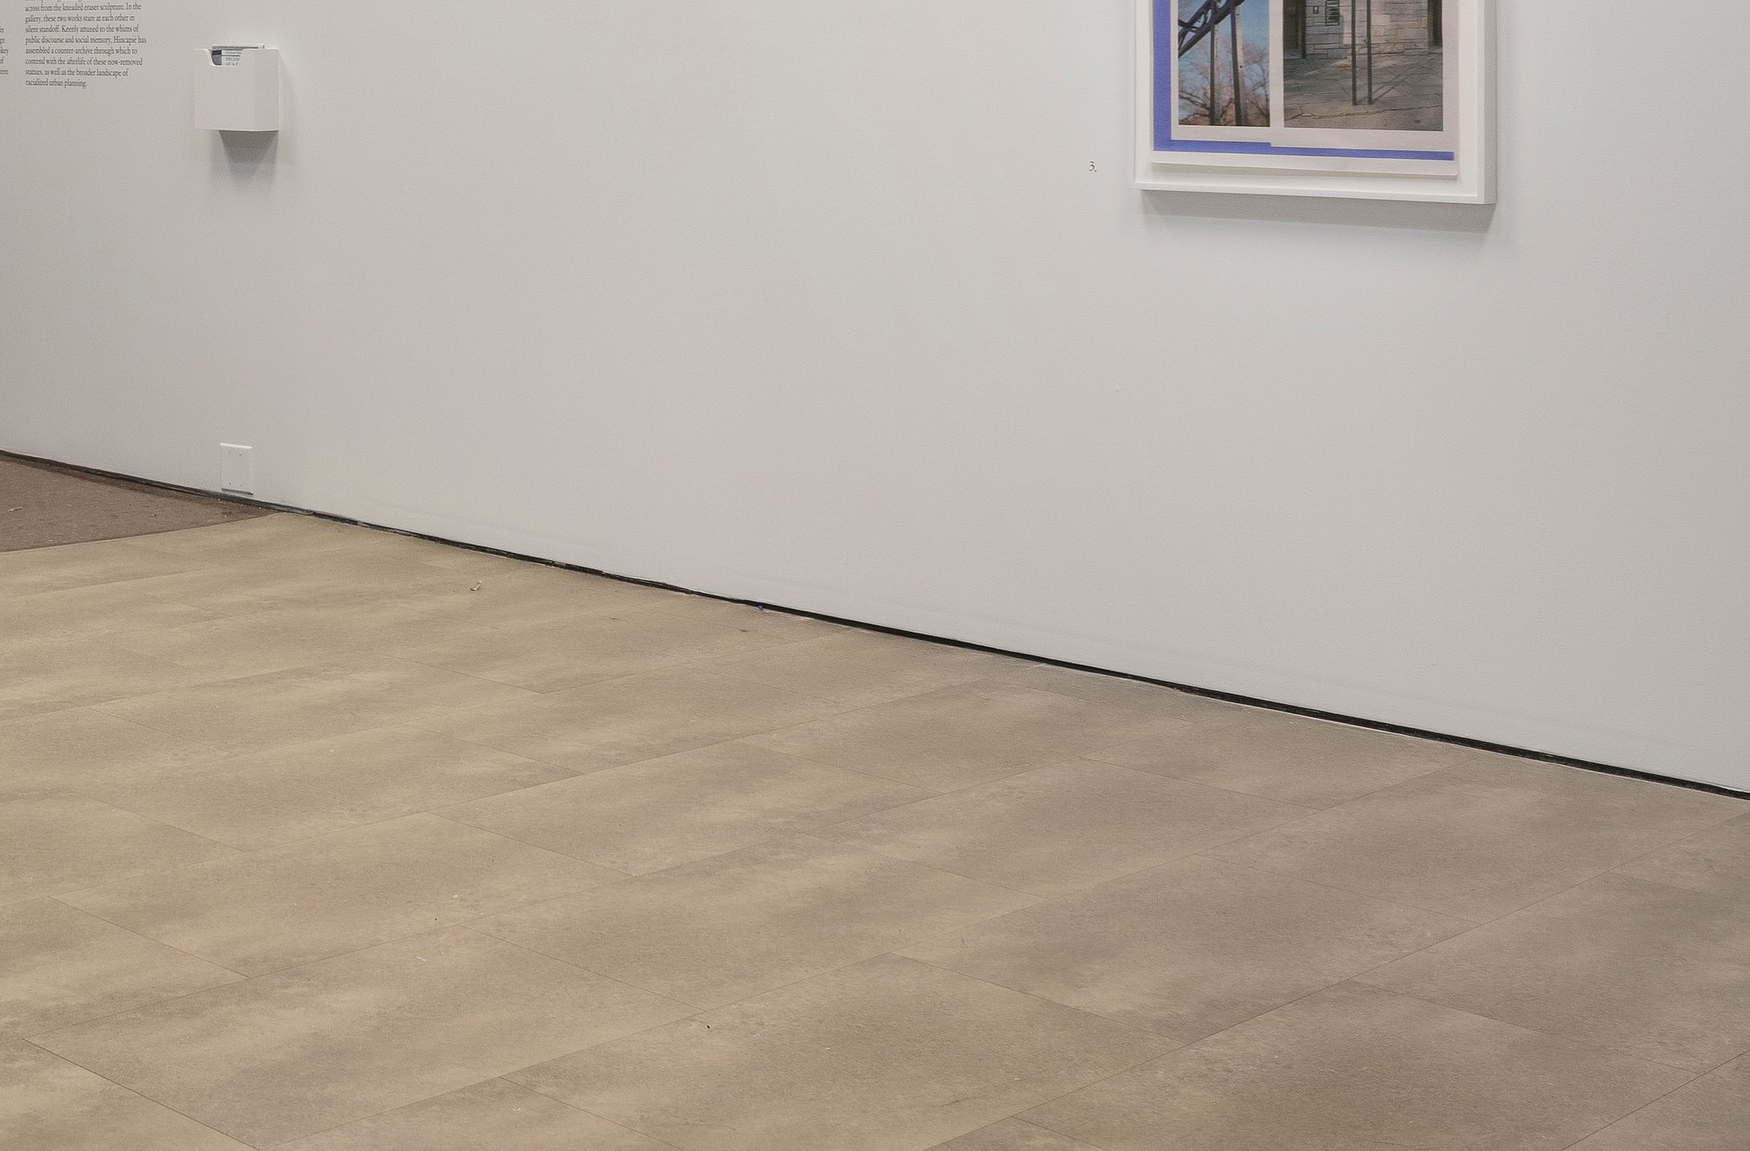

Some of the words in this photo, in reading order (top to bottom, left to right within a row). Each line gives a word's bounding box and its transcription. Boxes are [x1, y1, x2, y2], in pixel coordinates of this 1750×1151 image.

[26, 35, 40, 45] public
[42, 35, 64, 43] discourse
[138, 34, 146, 42] has
[1089, 161, 1097, 172] 3.
